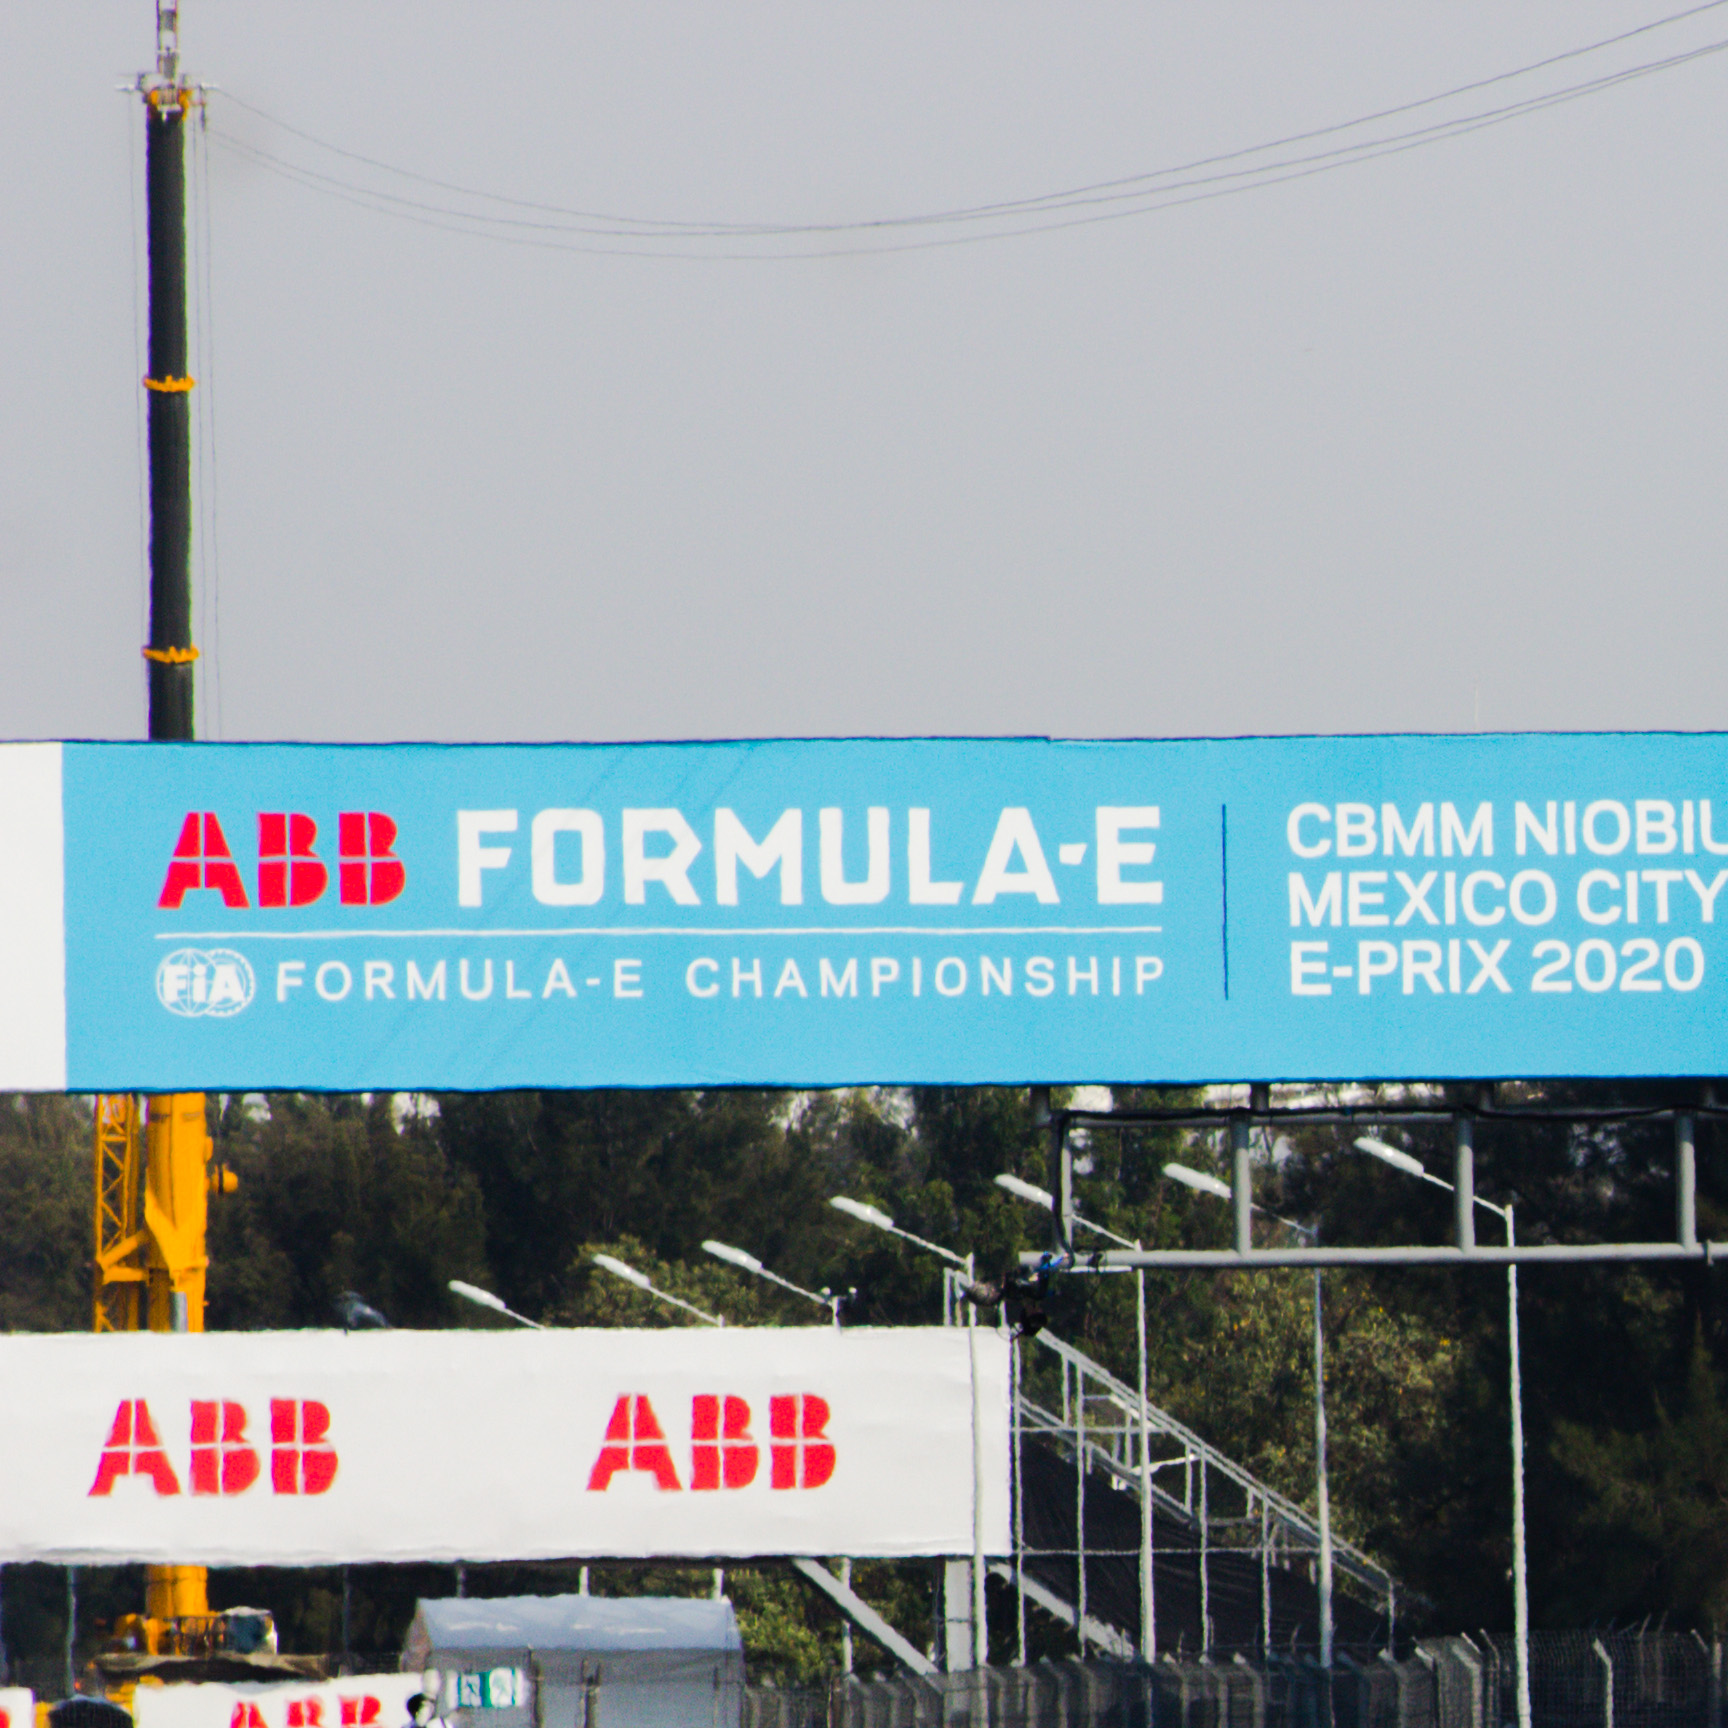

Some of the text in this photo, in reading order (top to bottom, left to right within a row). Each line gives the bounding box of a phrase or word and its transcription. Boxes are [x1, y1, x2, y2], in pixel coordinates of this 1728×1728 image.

[158, 805, 1164, 909] ABB FORMULA-E
[1286, 801, 1495, 859] CBMM
[1288, 869, 1559, 927] MEXICO
[277, 958, 645, 1003] FORMULA-E
[686, 956, 1165, 999] CHAMPIONSHIP
[1290, 936, 1706, 996] E-PRIX 2020
[88, 1398, 338, 1497] ABB
[586, 1394, 836, 1491] ABB
